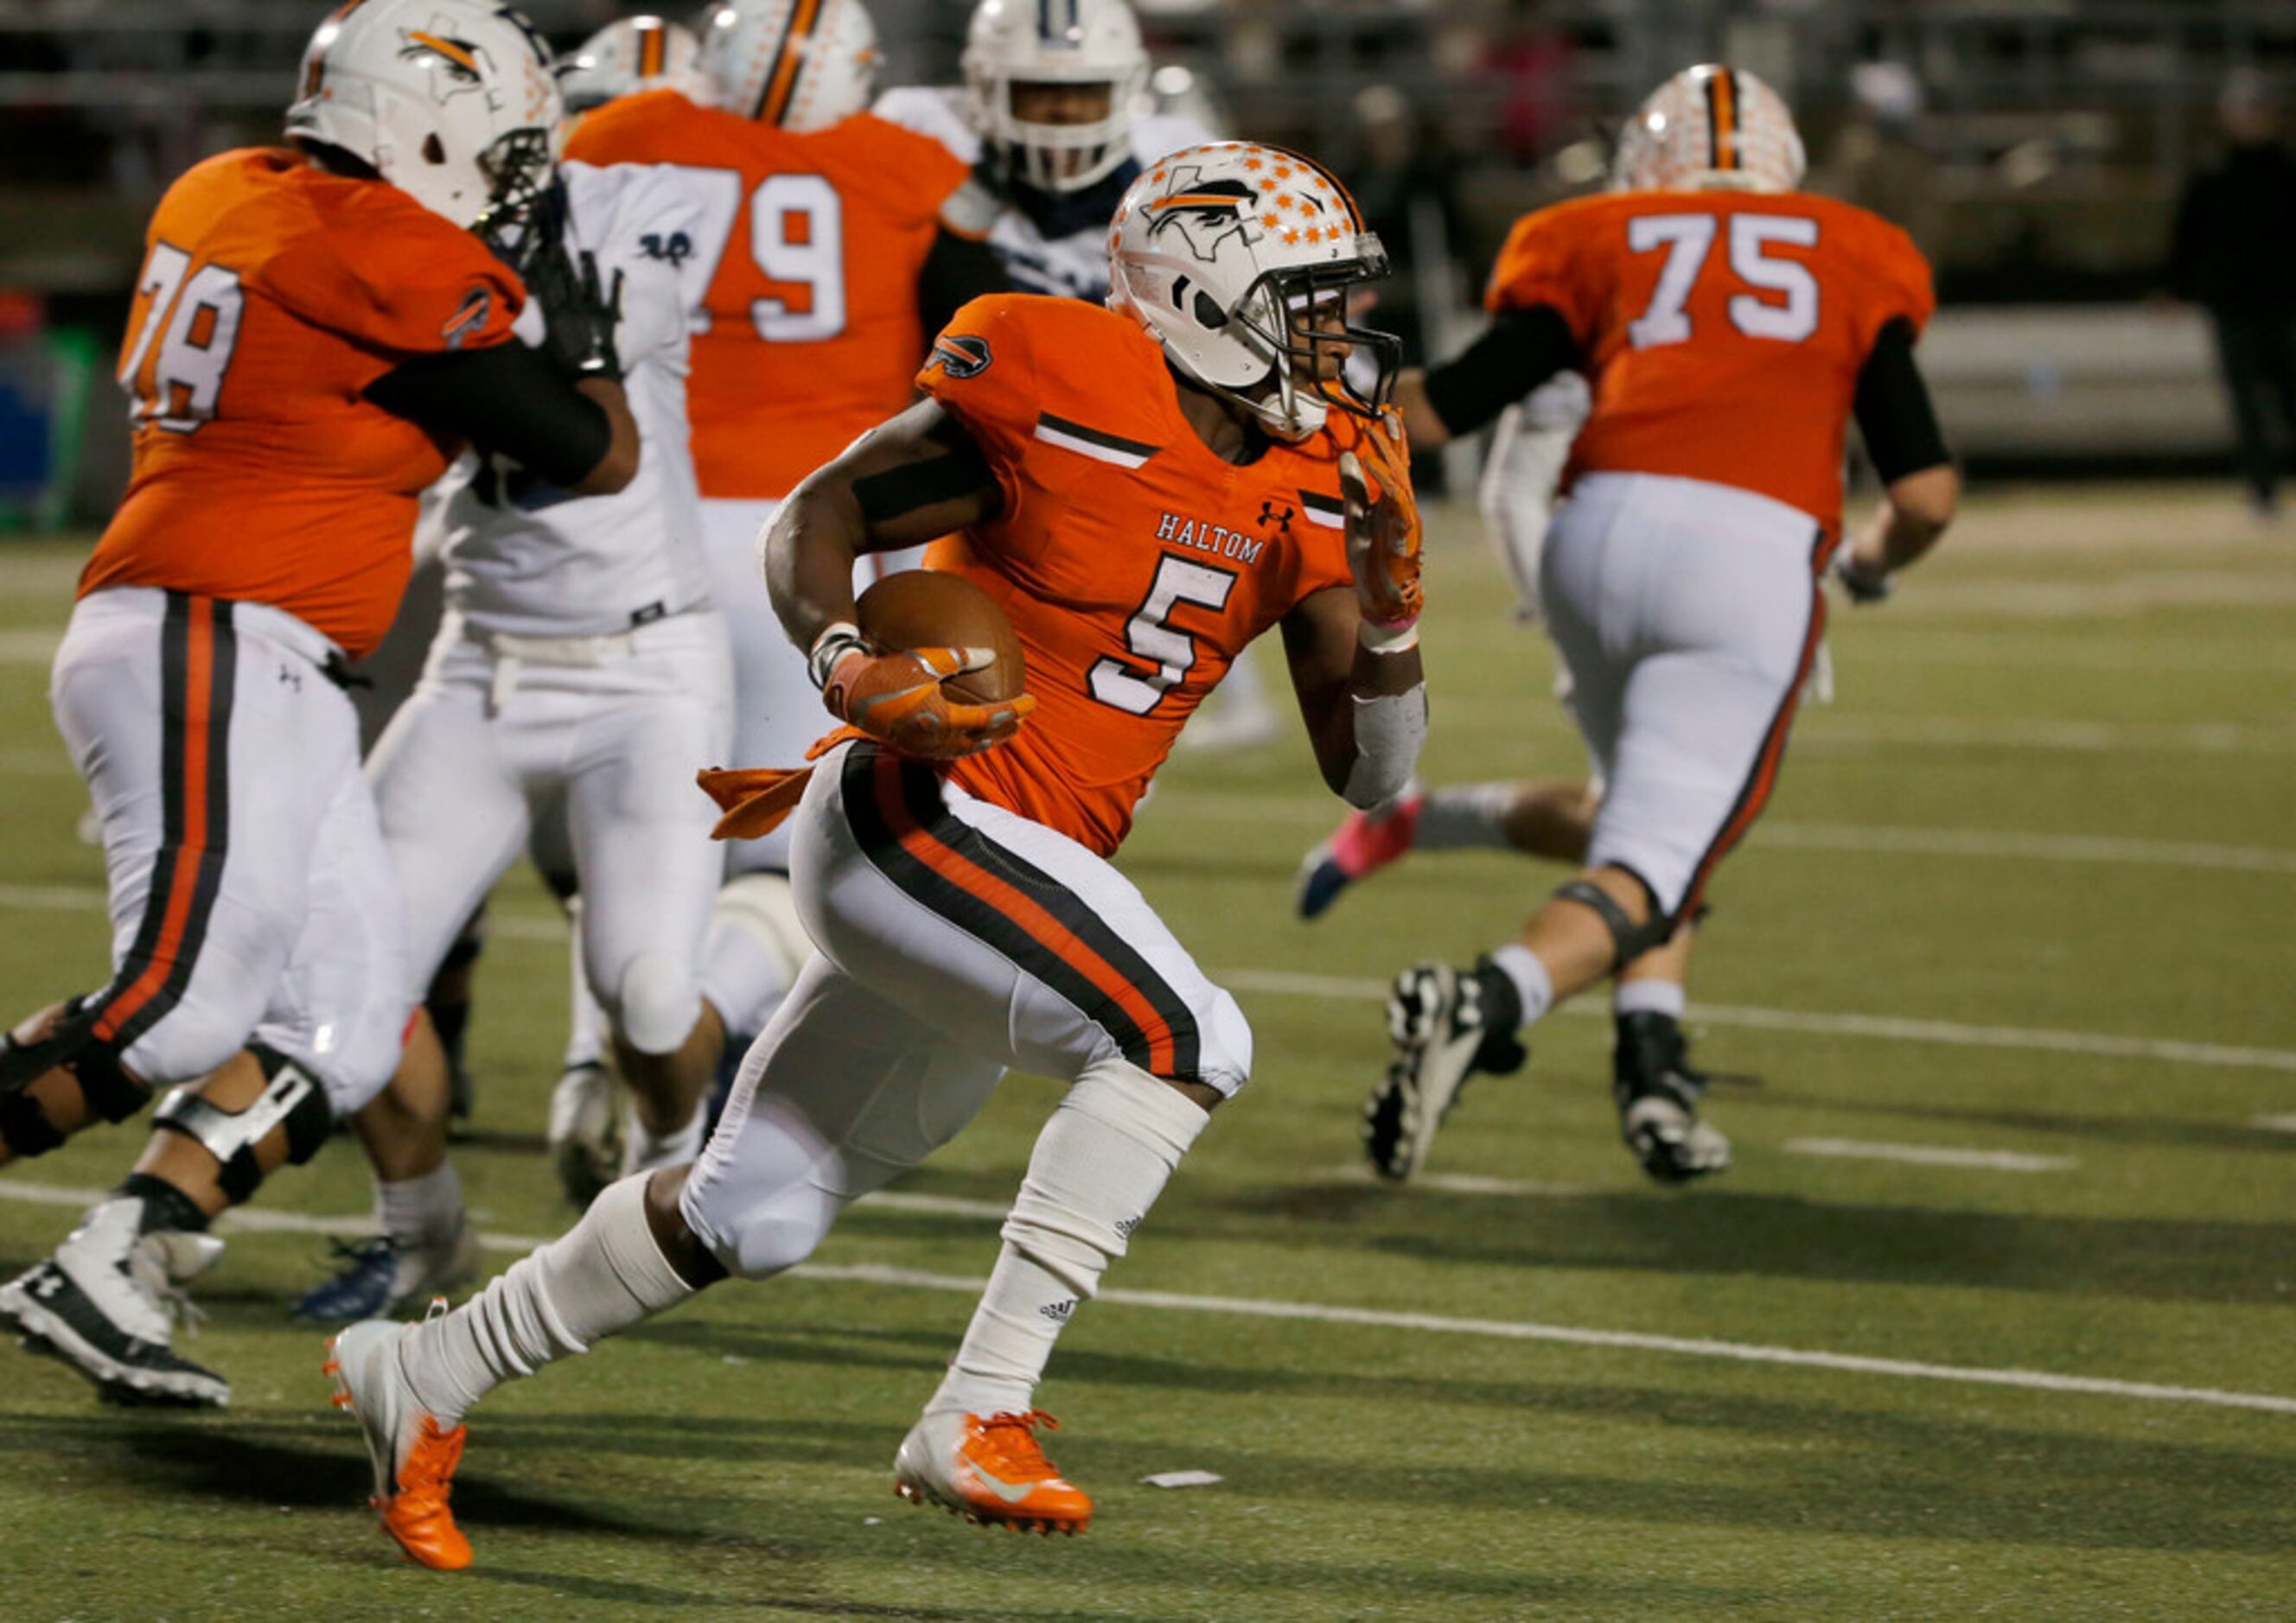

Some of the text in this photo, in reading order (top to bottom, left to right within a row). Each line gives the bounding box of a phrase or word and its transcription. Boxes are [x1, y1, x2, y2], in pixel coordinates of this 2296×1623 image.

[118, 239, 246, 435] 78
[1626, 213, 1821, 353] 75
[1156, 512, 1265, 565] HALTOM
[1087, 551, 1239, 716] 5
